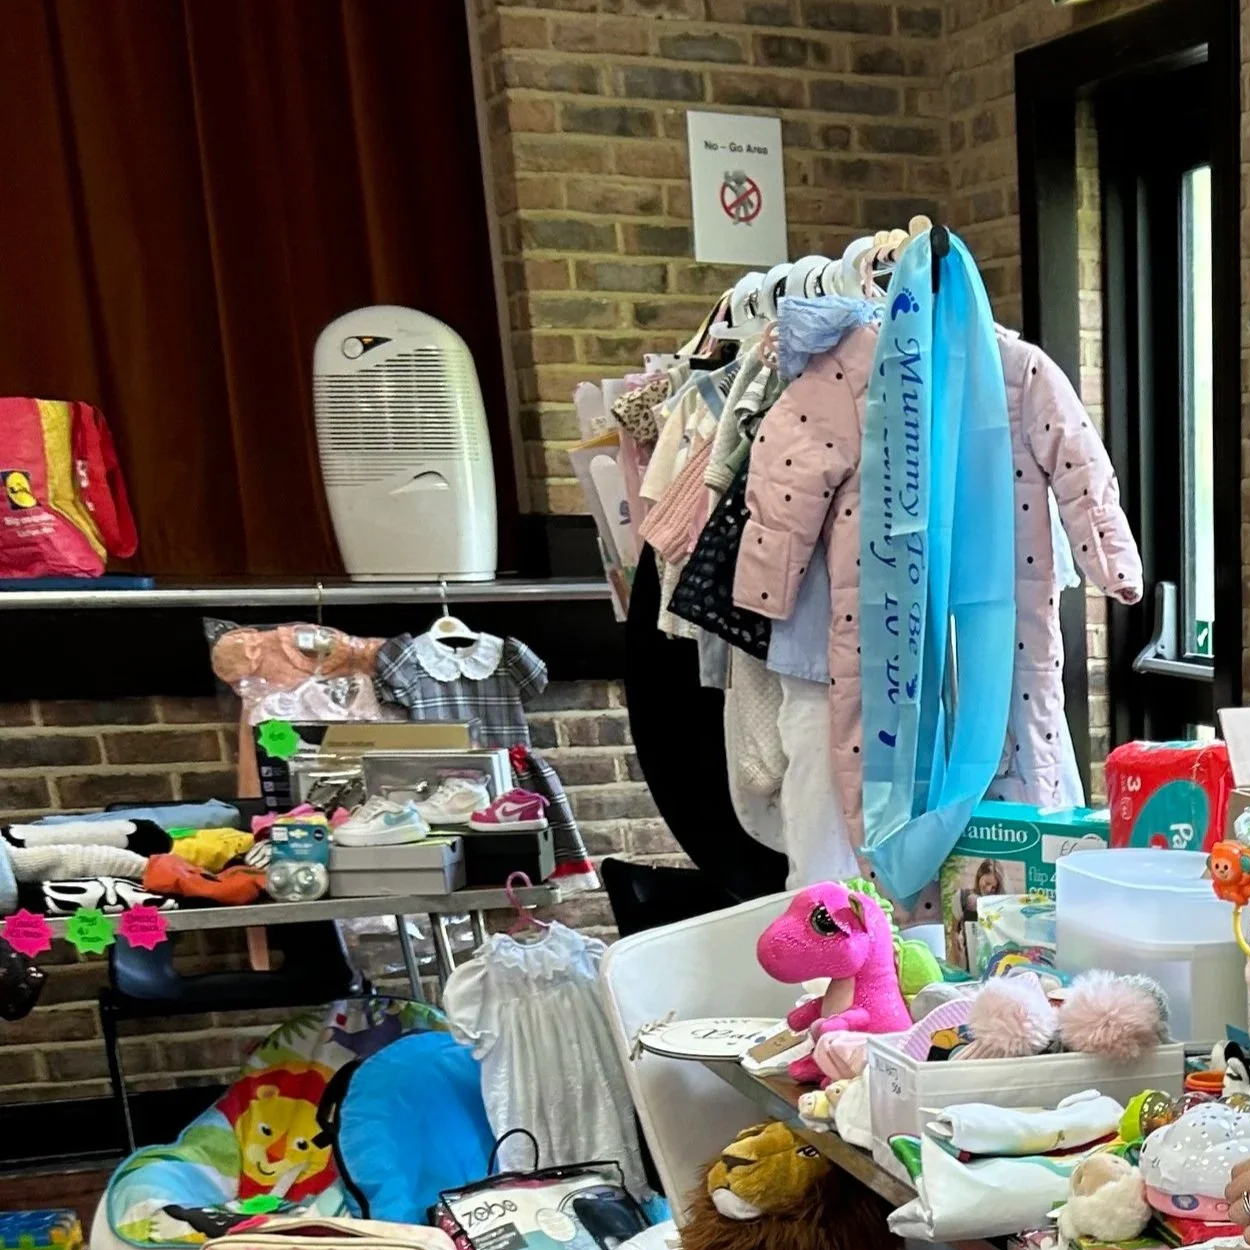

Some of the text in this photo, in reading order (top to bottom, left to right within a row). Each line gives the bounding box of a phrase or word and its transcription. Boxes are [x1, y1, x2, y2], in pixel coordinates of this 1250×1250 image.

[703, 140, 718, 151] No
[729, 142, 743, 152] Go
[746, 144, 768, 155] Area
[894, 337, 925, 656] Mummy To Be
[1127, 775, 1141, 792] 3
[964, 823, 1028, 844] antino
